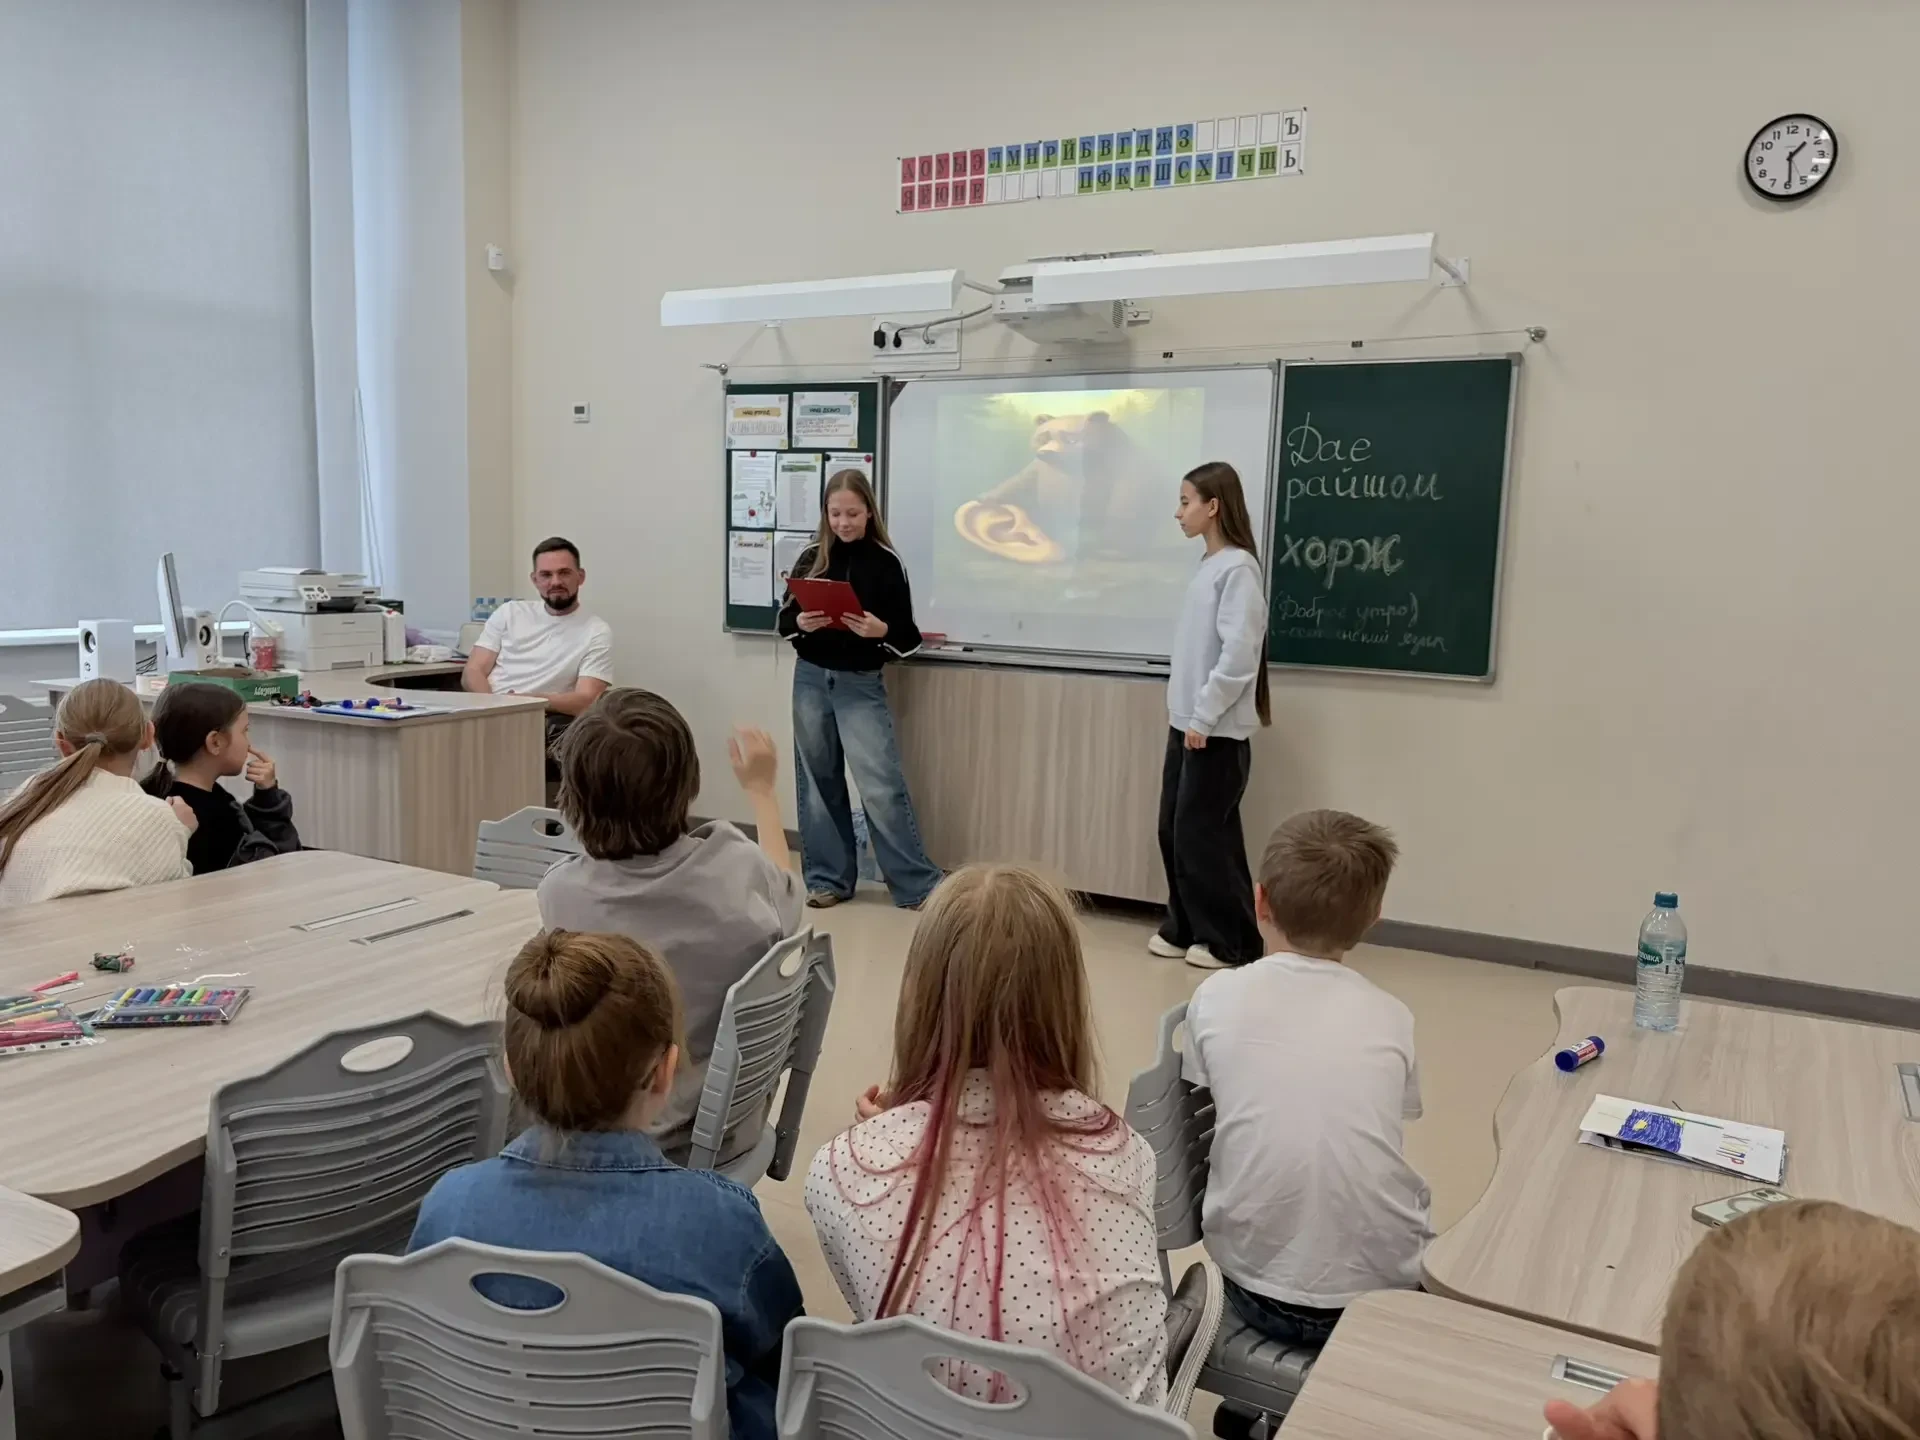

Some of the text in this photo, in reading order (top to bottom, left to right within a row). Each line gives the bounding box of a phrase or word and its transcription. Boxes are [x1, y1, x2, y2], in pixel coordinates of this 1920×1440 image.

[1786, 125, 1799, 135] 12
[1806, 128, 1810, 137] 1
[1773, 130, 1781, 140] 11
[1813, 136, 1822, 145] 2
[1761, 141, 1773, 150] 10
[1817, 150, 1825, 158] 3
[1756, 156, 1764, 165] 9
[1758, 169, 1767, 178] 8
[1811, 165, 1819, 173] 4
[1769, 178, 1777, 188] 7
[1800, 175, 1808, 185] 5
[1784, 180, 1792, 190] 6
[1286, 412, 1372, 467] Дае
[1284, 467, 1444, 523] райшом
